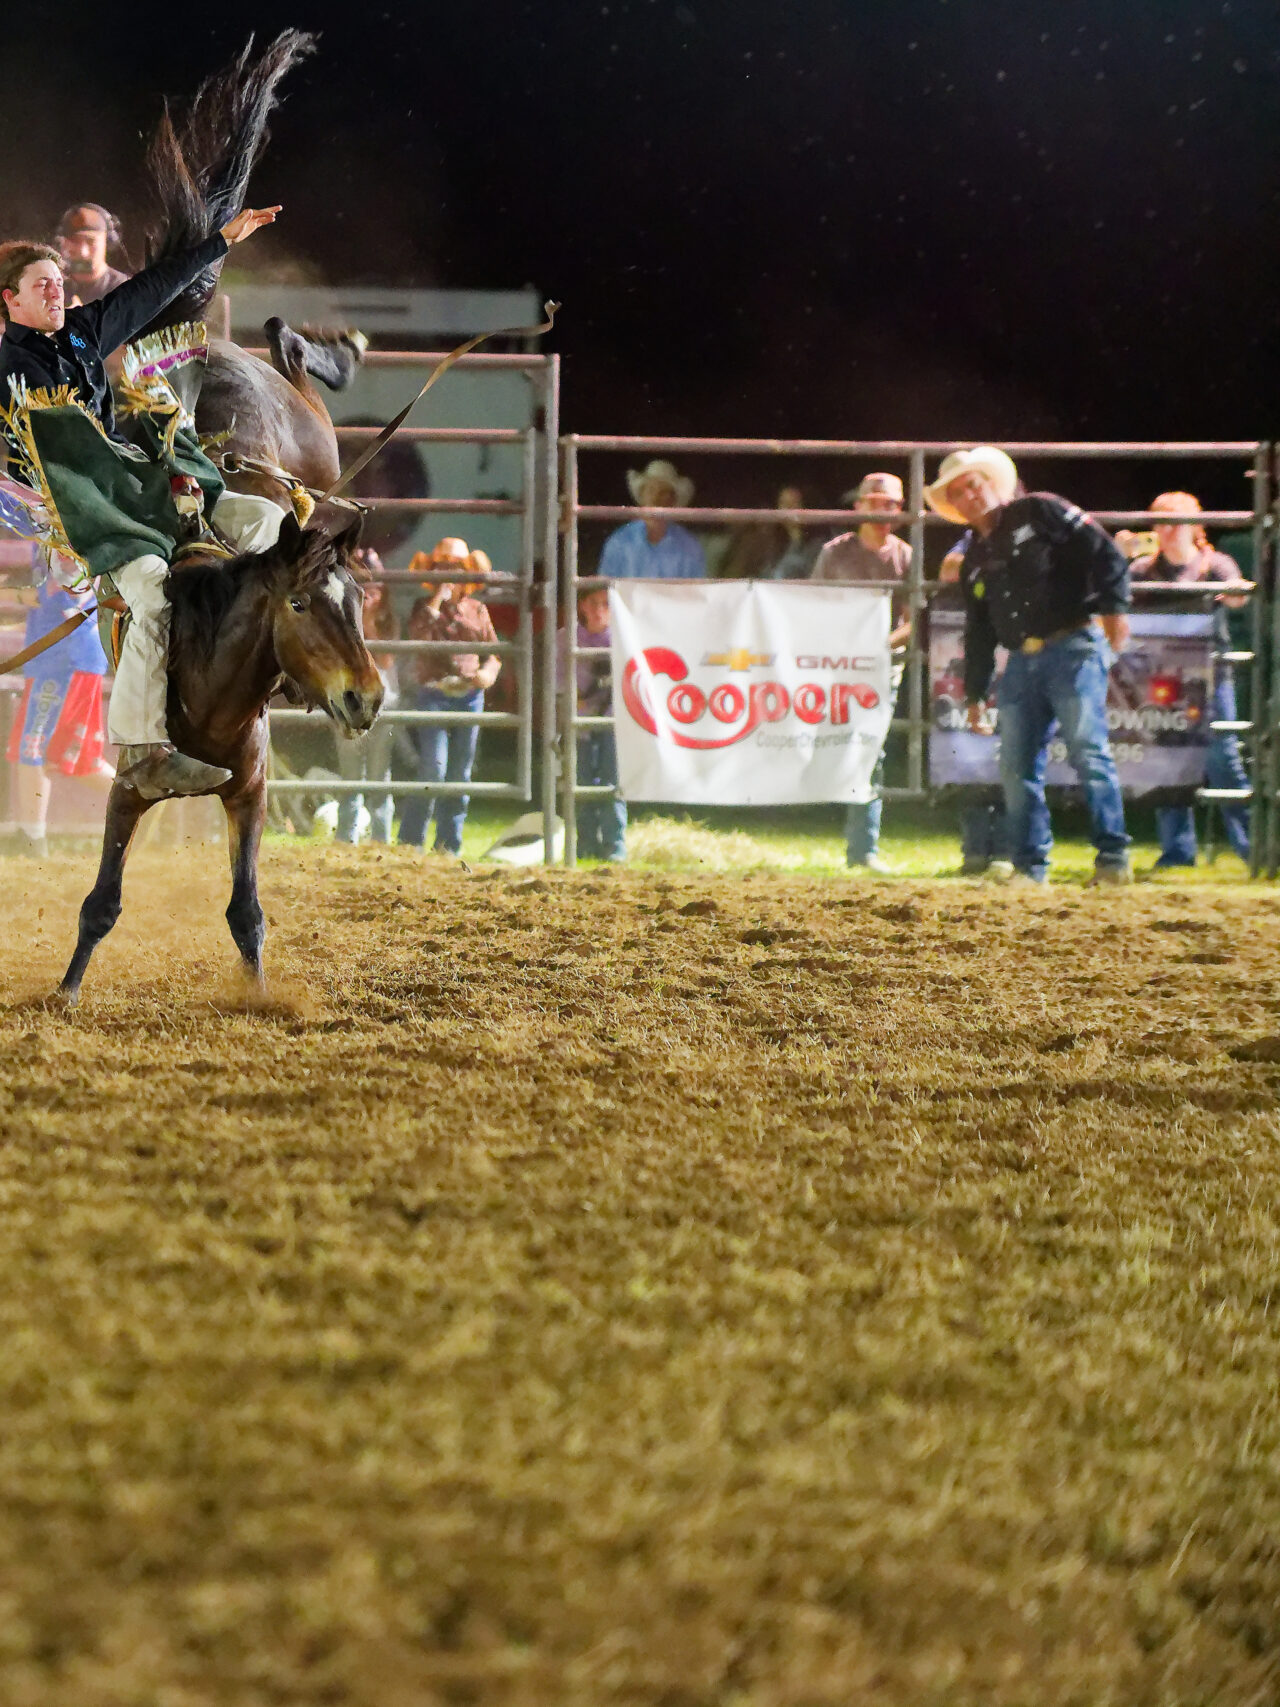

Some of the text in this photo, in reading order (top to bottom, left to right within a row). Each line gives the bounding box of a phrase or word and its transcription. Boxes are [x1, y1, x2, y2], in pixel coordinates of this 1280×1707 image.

[795, 655, 877, 671] GMC
[622, 646, 880, 750] Cooper
[1104, 708, 1188, 731] OWING
